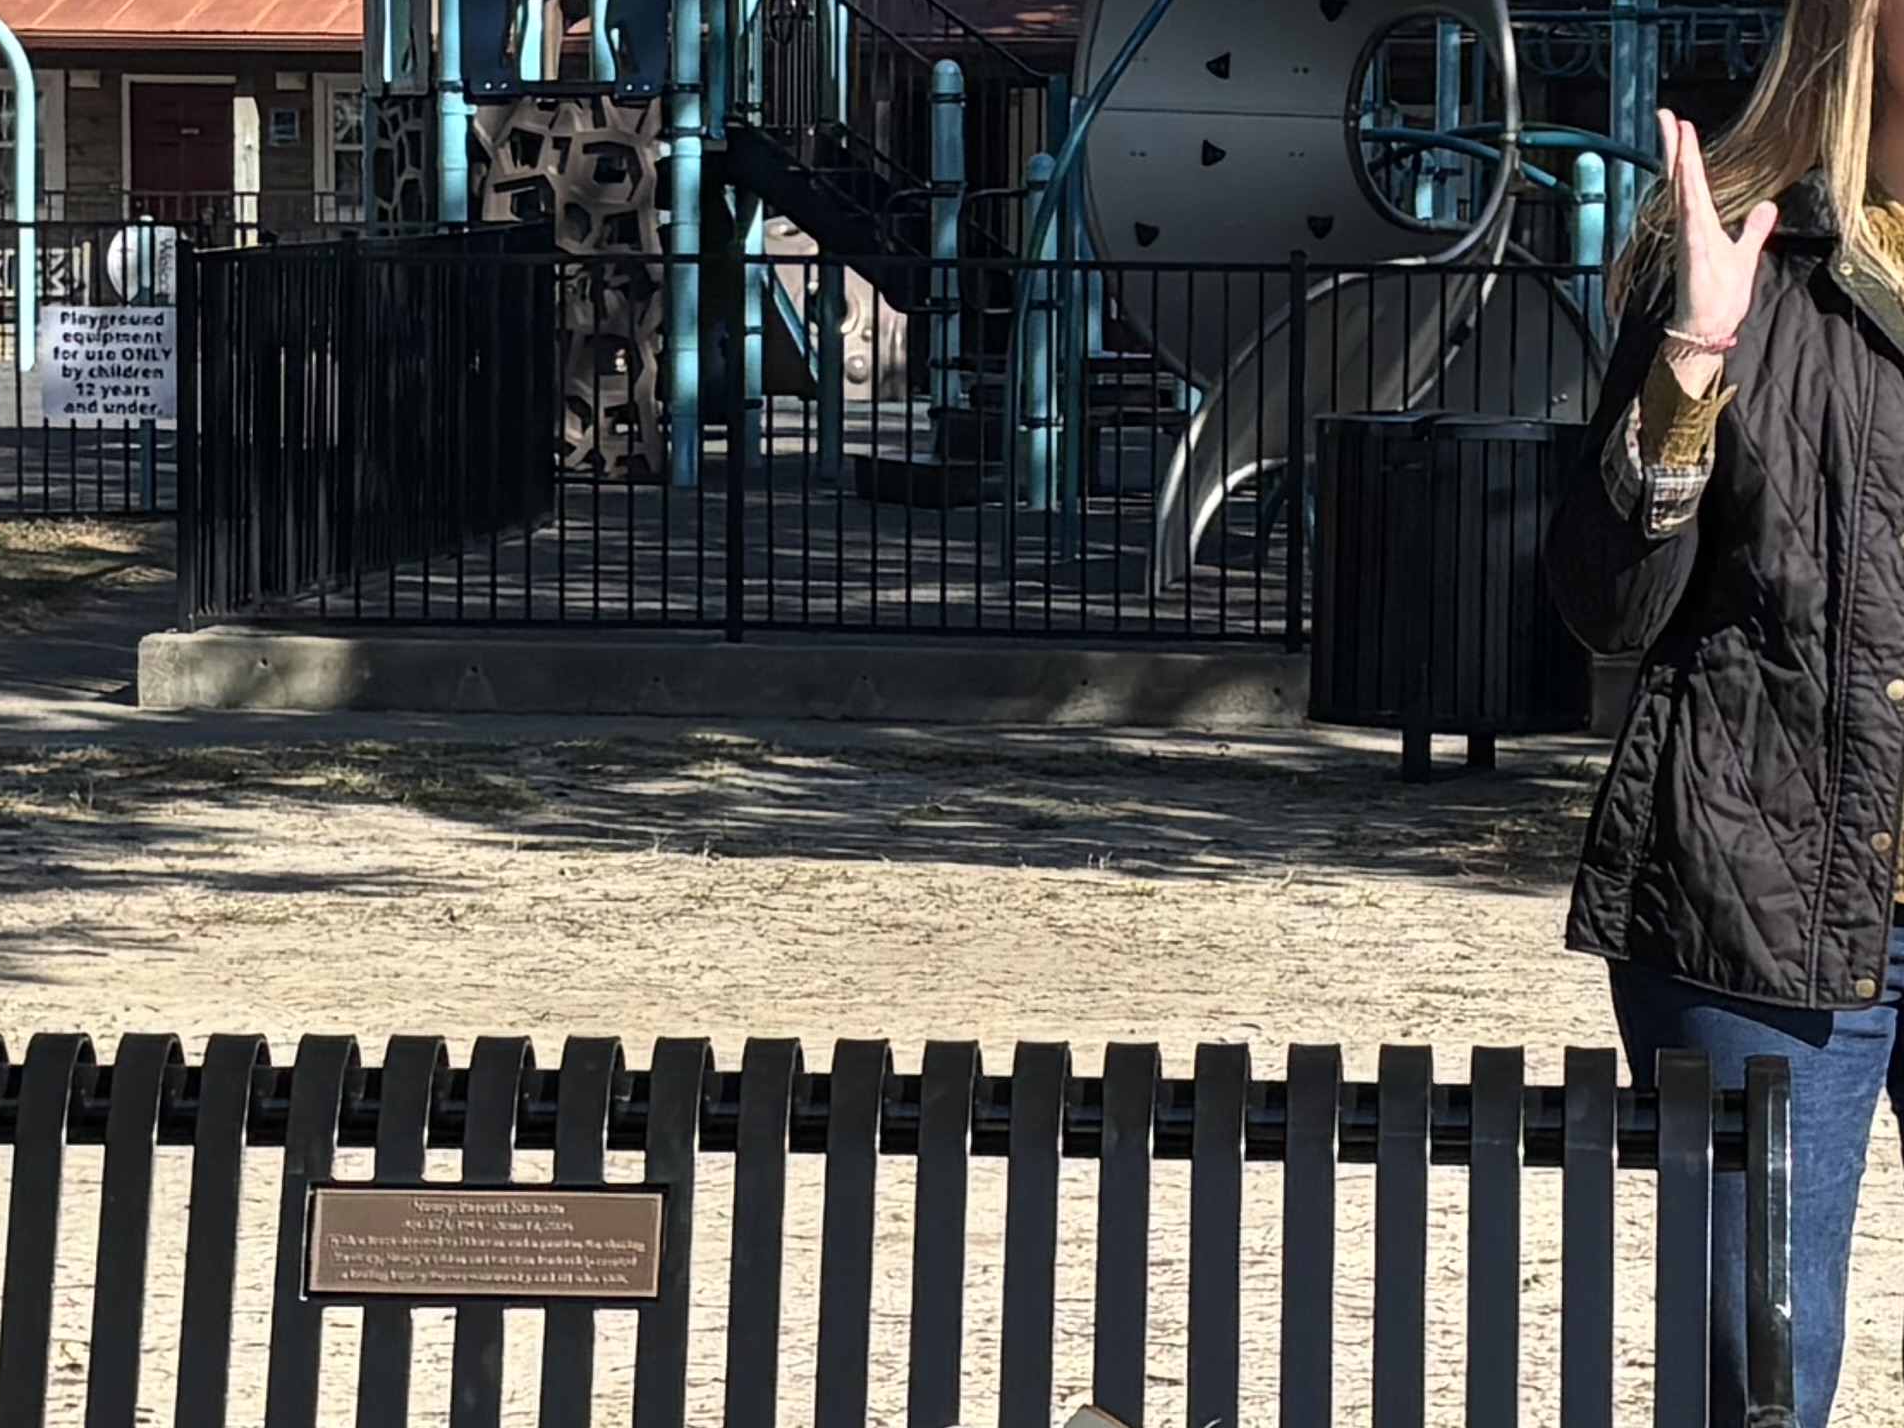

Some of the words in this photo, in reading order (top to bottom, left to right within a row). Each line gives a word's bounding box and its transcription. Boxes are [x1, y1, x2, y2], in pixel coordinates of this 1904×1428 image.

[60, 311, 165, 330] Playground
[62, 333, 162, 347] equipment
[53, 345, 80, 361] for
[85, 349, 116, 361] use
[121, 347, 172, 361] ONLY
[62, 364, 84, 381] by
[88, 364, 164, 379] children
[75, 382, 95, 396] 12
[100, 384, 150, 400] years
[63, 400, 98, 414] and
